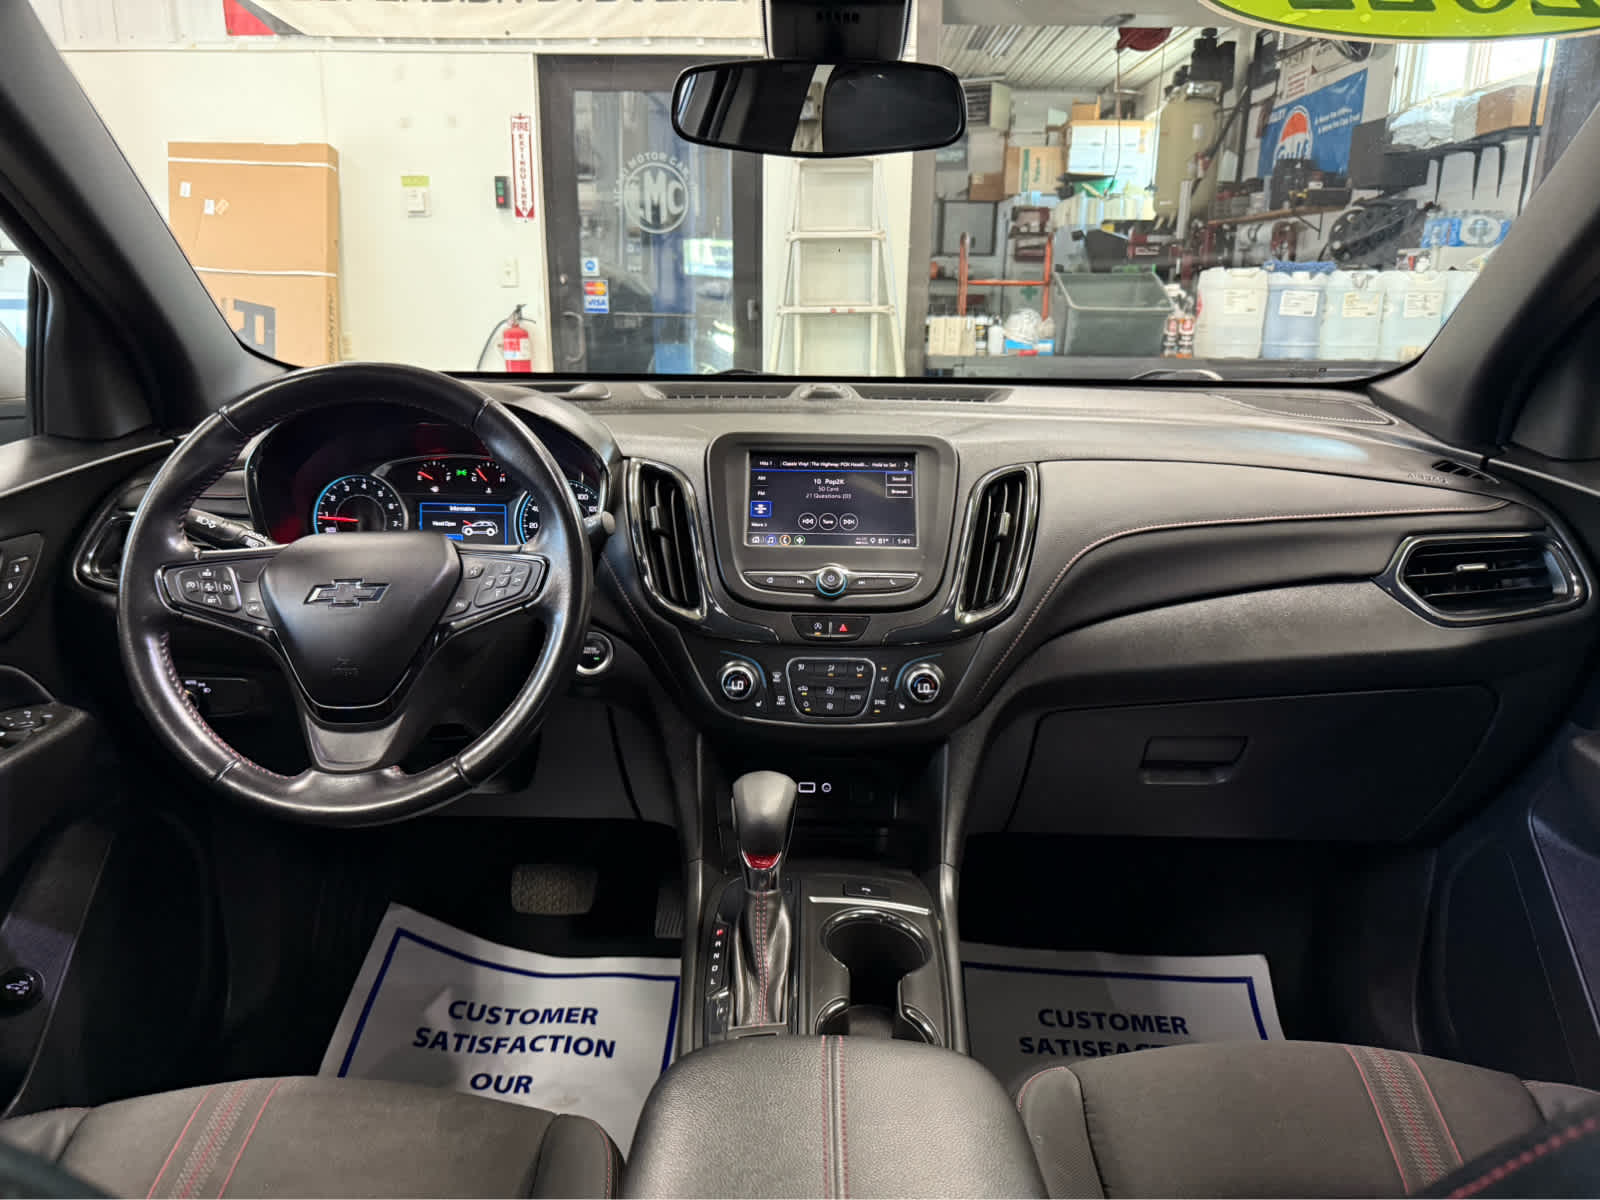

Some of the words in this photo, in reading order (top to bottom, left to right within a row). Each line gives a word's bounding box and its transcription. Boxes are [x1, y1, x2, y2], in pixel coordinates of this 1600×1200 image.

[511, 121, 529, 131] FIRE
[825, 478, 845, 486] Pop2K
[731, 680, 744, 690] LO
[917, 682, 930, 693] LO
[448, 999, 600, 1026] CUSTOMER
[1037, 1008, 1190, 1035] CUSTOMER
[412, 1026, 617, 1060] SATISFACTION
[1018, 1036, 1170, 1060] SATISFA
[469, 1072, 534, 1095] OUR
